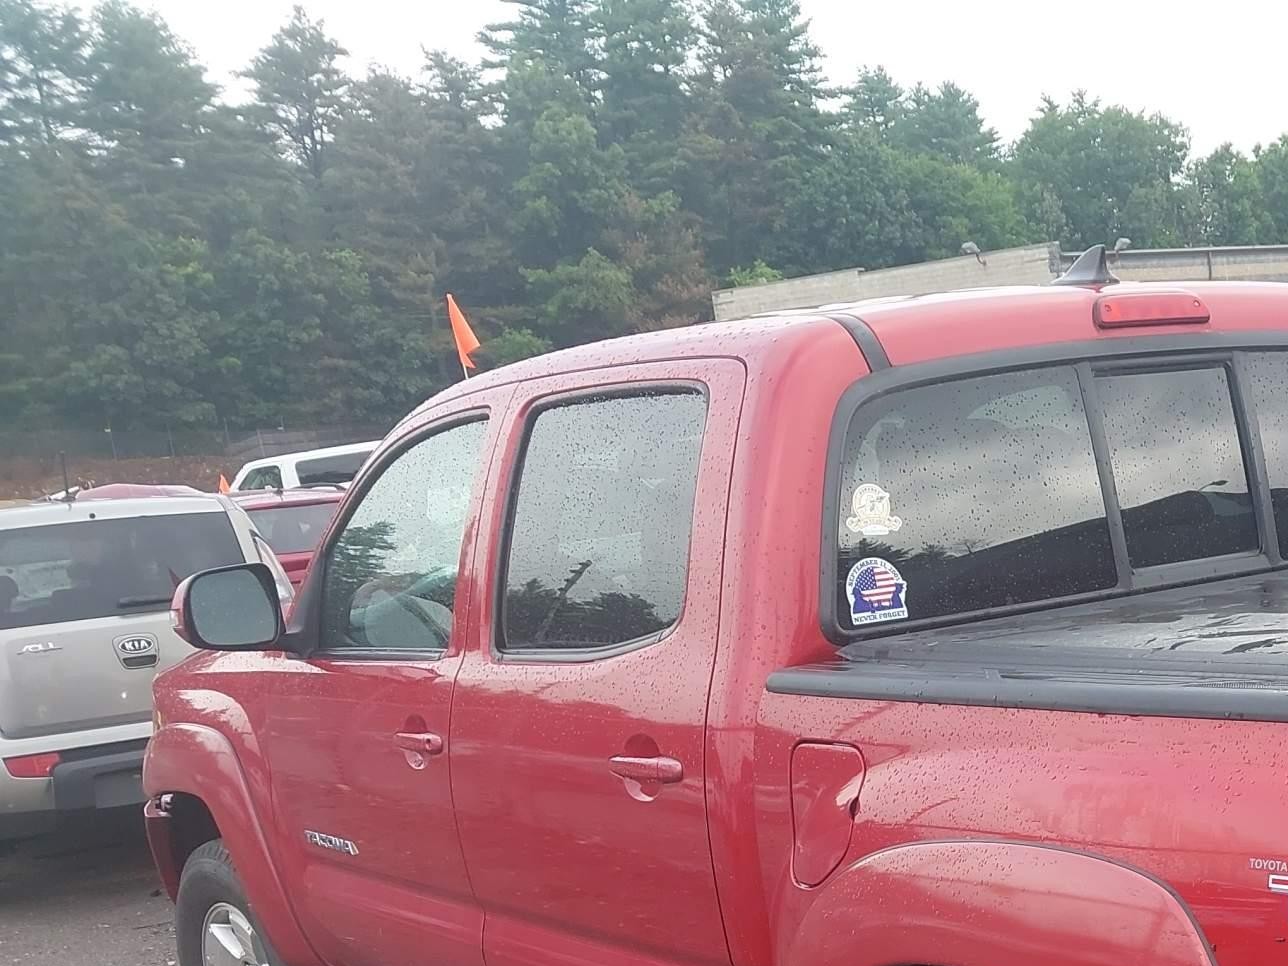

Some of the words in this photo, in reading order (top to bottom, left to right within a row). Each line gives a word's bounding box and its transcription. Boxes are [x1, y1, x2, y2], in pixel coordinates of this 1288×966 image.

[848, 559, 878, 587] SEPTEMBER
[854, 614, 877, 624] NEVER
[878, 610, 905, 620] FORGET
[123, 640, 149, 651] KIA
[1249, 858, 1288, 872] TOYOTA
